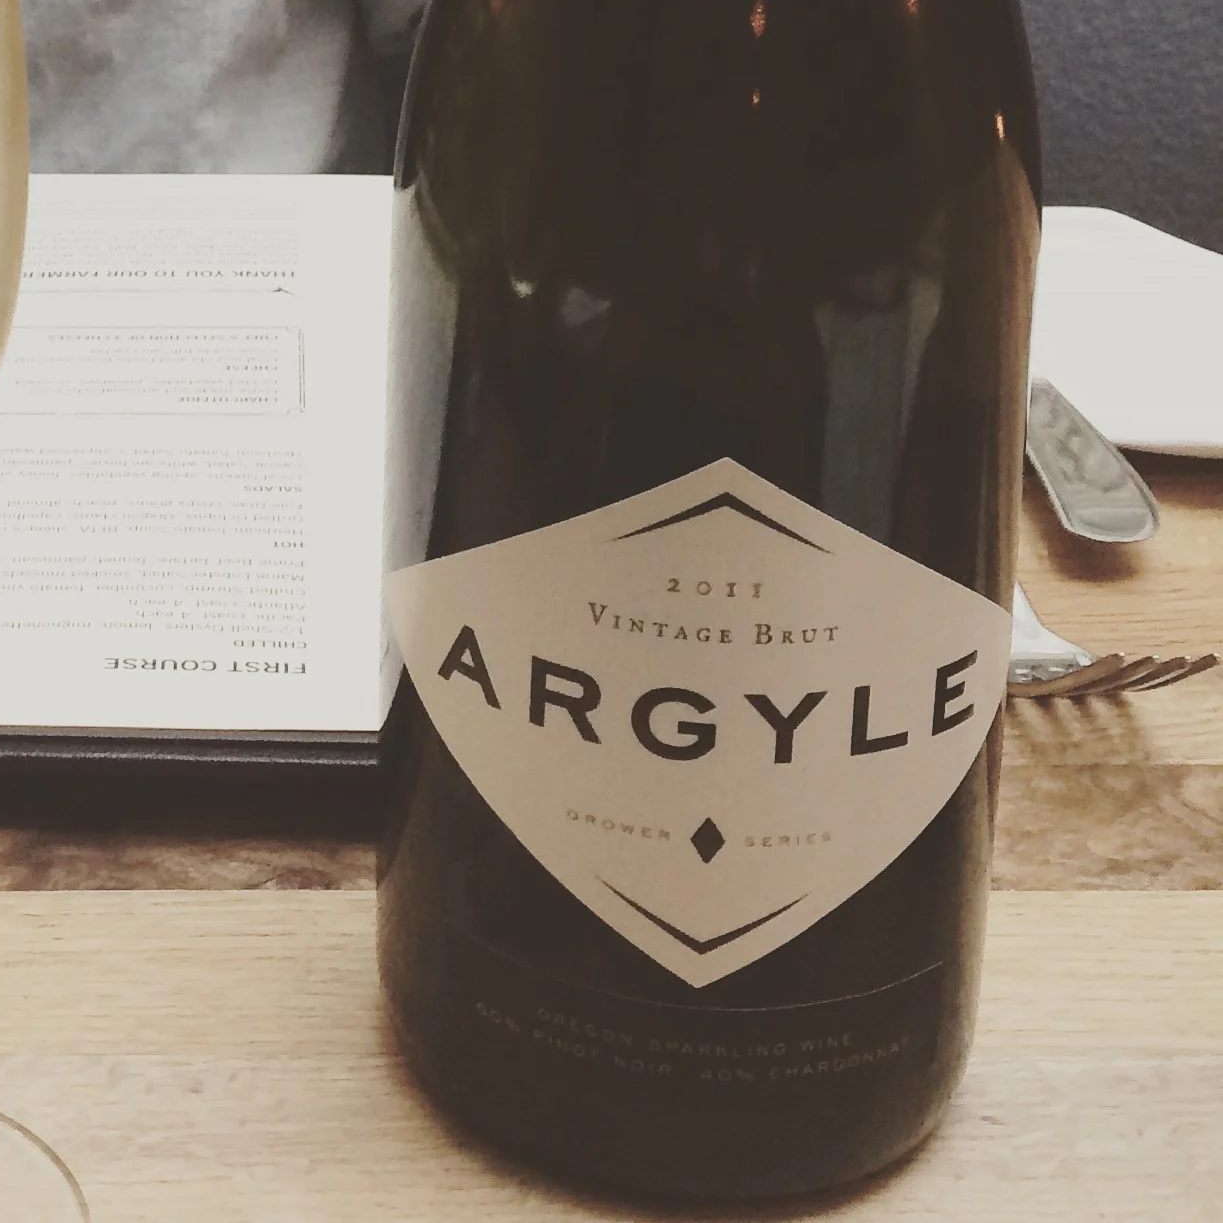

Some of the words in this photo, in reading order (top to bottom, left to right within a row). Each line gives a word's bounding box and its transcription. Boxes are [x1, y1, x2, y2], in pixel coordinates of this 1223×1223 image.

[22, 270, 99, 279] FARMER
[107, 269, 148, 279] OUR
[154, 269, 176, 279] TO
[185, 269, 224, 279] YOU
[233, 269, 296, 279] THANK
[243, 484, 304, 493] SALADS
[272, 540, 305, 549] HOT
[665, 577, 764, 600] 2011
[587, 601, 735, 646] VINTAGE
[754, 623, 841, 647] BRUT
[232, 639, 307, 650] CHILLED
[103, 657, 217, 672] COURSE
[227, 661, 307, 675] FIRST
[437, 624, 980, 764] ARGYLE
[565, 808, 673, 841] GROWER
[744, 829, 833, 848] SERIES
[536, 1006, 634, 1046] OREGON
[648, 1036, 787, 1058] SPARKLING
[799, 1032, 854, 1054] WINE
[532, 1028, 603, 1060] PINOT
[614, 1055, 673, 1077] NOIR
